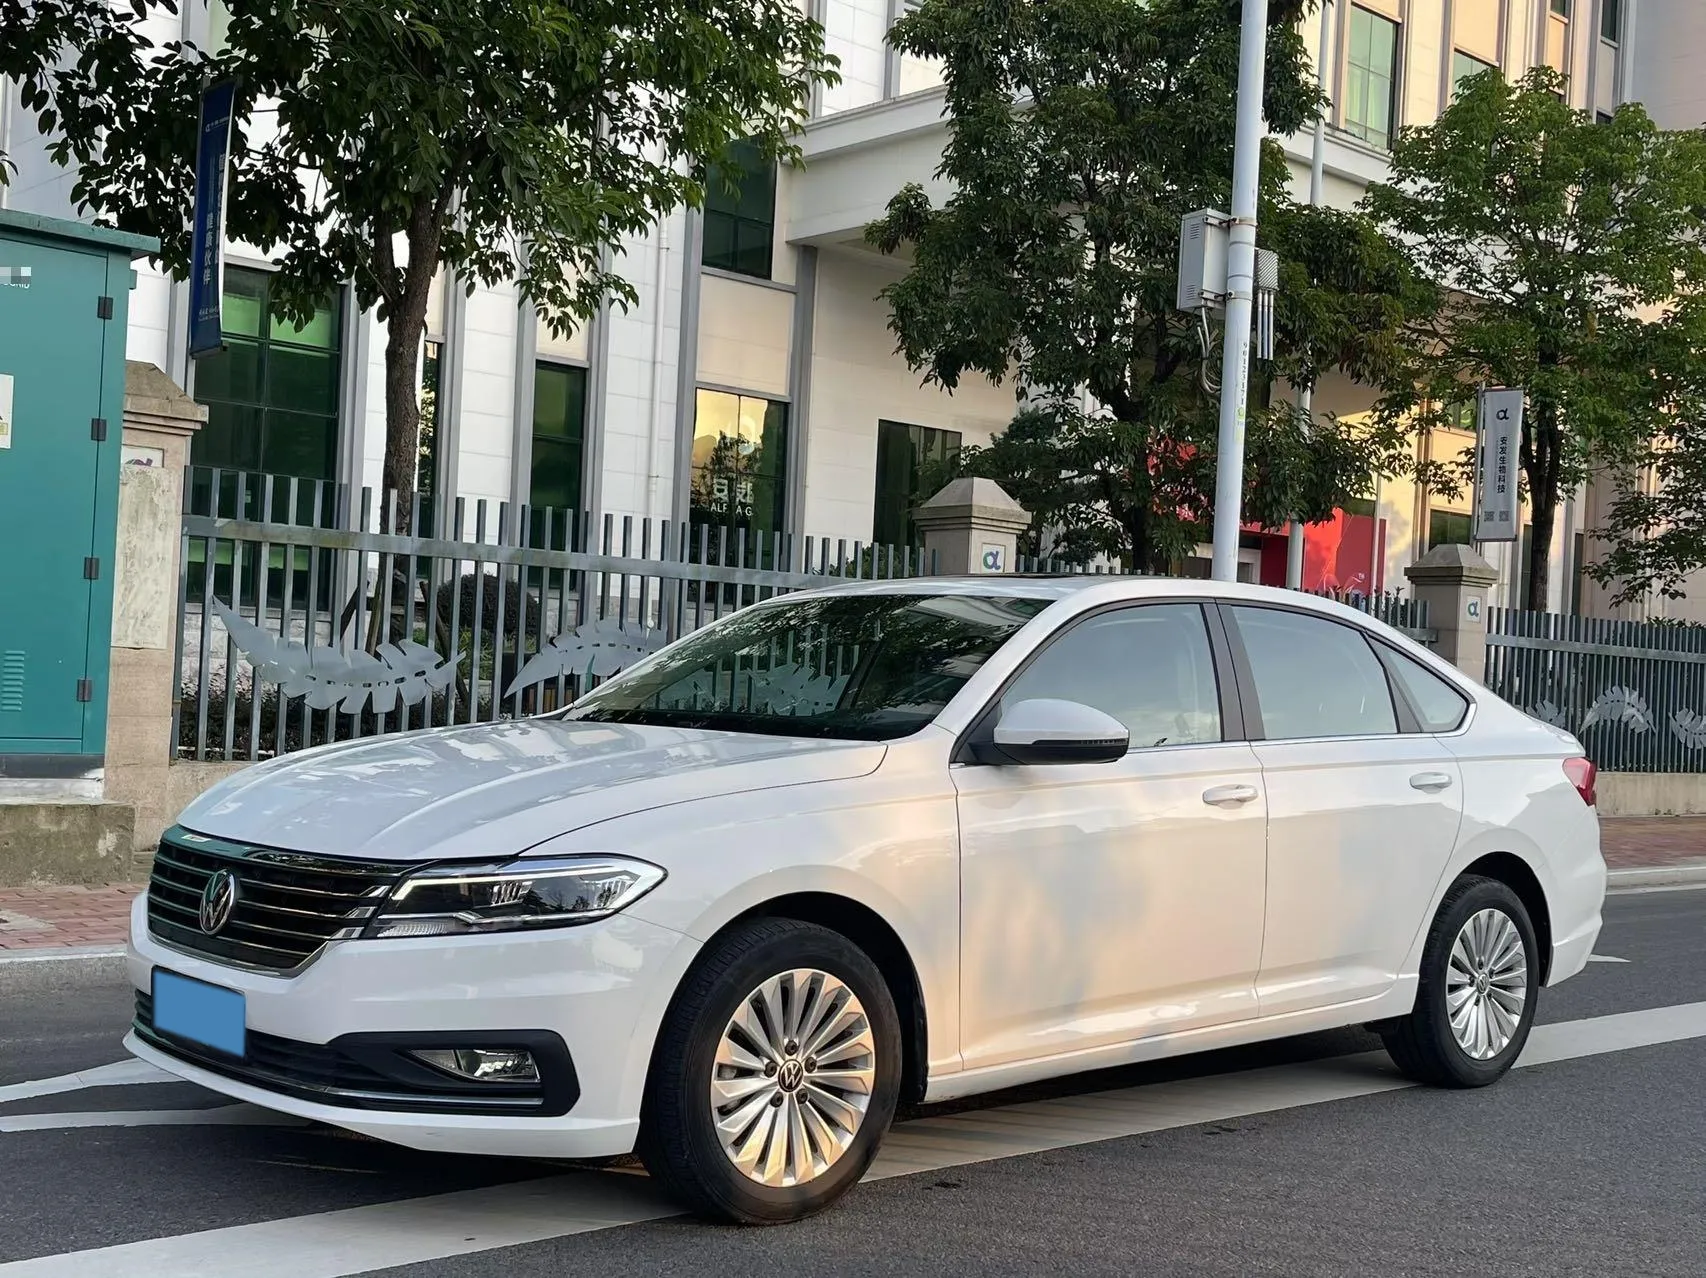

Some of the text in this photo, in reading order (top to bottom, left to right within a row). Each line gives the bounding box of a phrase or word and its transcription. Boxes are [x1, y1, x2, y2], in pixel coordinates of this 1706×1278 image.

[1496, 436, 1508, 494] 安发生物科技
